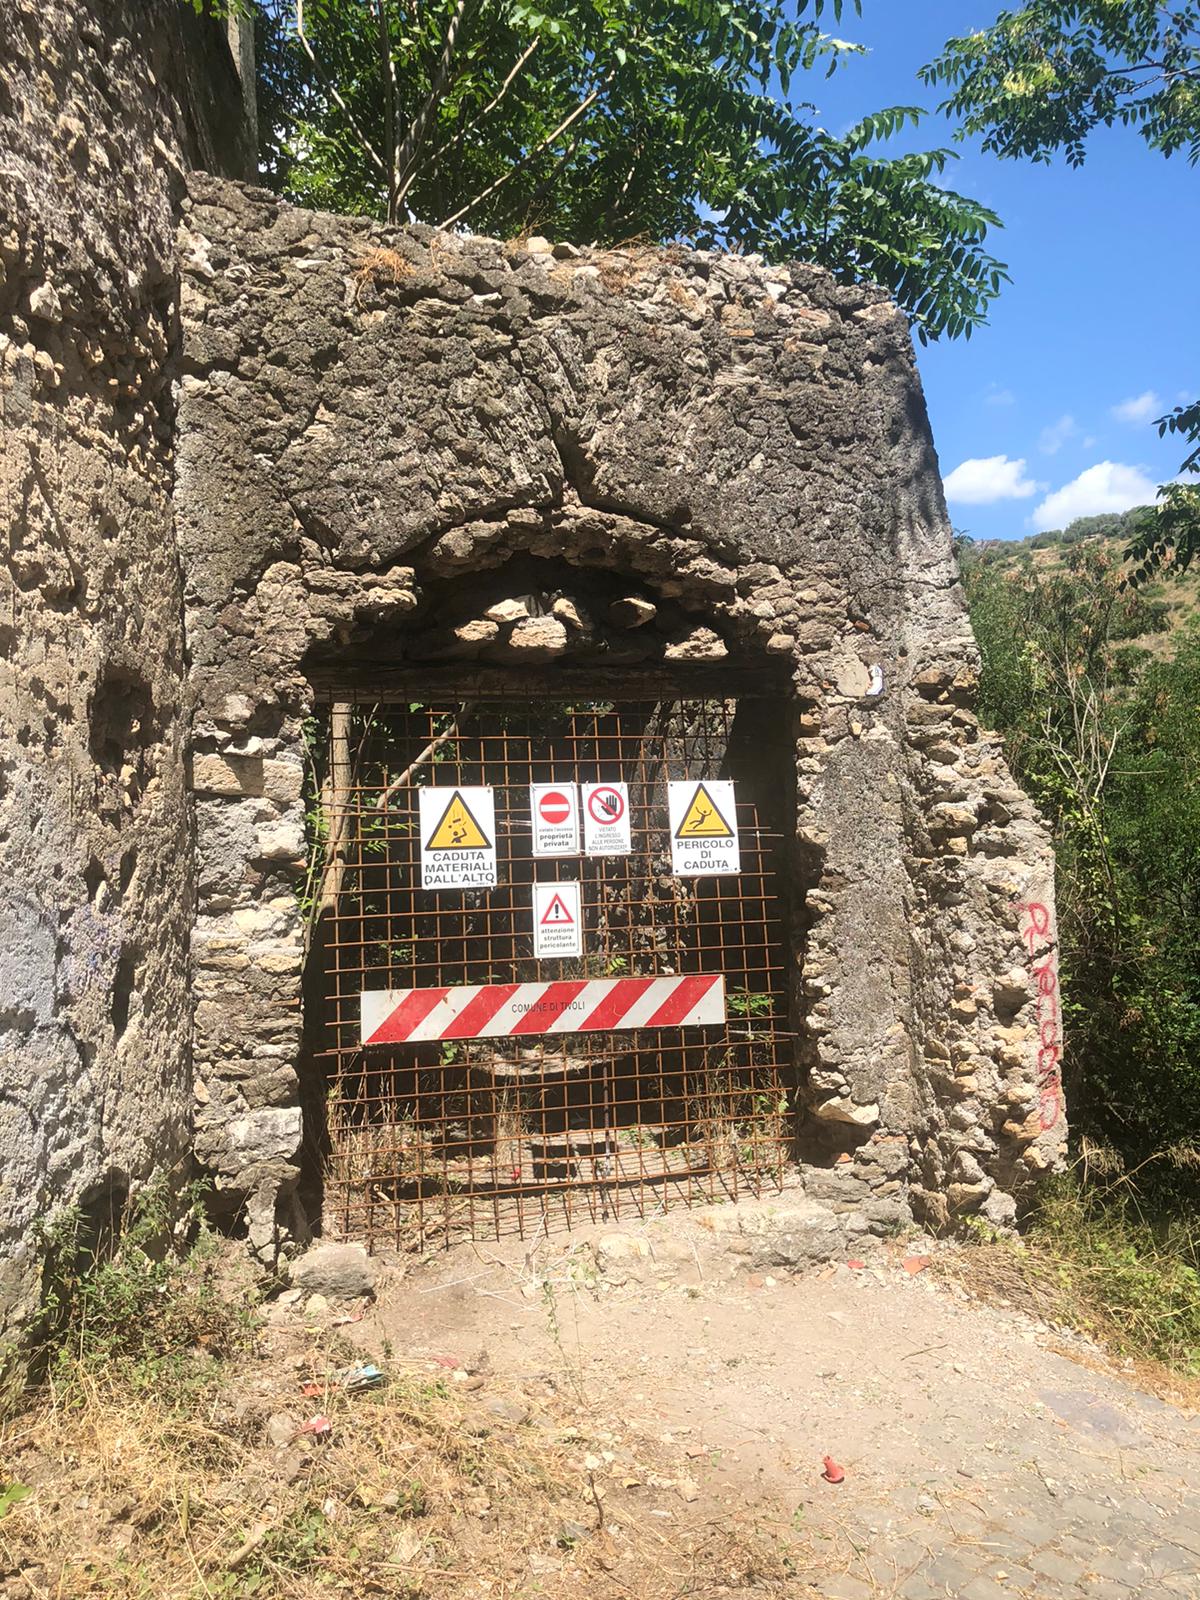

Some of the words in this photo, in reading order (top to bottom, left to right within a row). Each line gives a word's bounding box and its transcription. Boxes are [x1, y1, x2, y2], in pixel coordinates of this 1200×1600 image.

[677, 839, 734, 850] PERICOLO
[432, 851, 485, 862] CADUTA
[700, 850, 712, 859] DI
[425, 861, 493, 873] MATERIALI
[683, 859, 729, 870] CADUTA
[424, 872, 495, 885] DALL'ALTO
[511, 1002, 548, 1013] COMUNE
[549, 1002, 558, 1011] DI
[561, 1001, 585, 1011] TIVOLI
